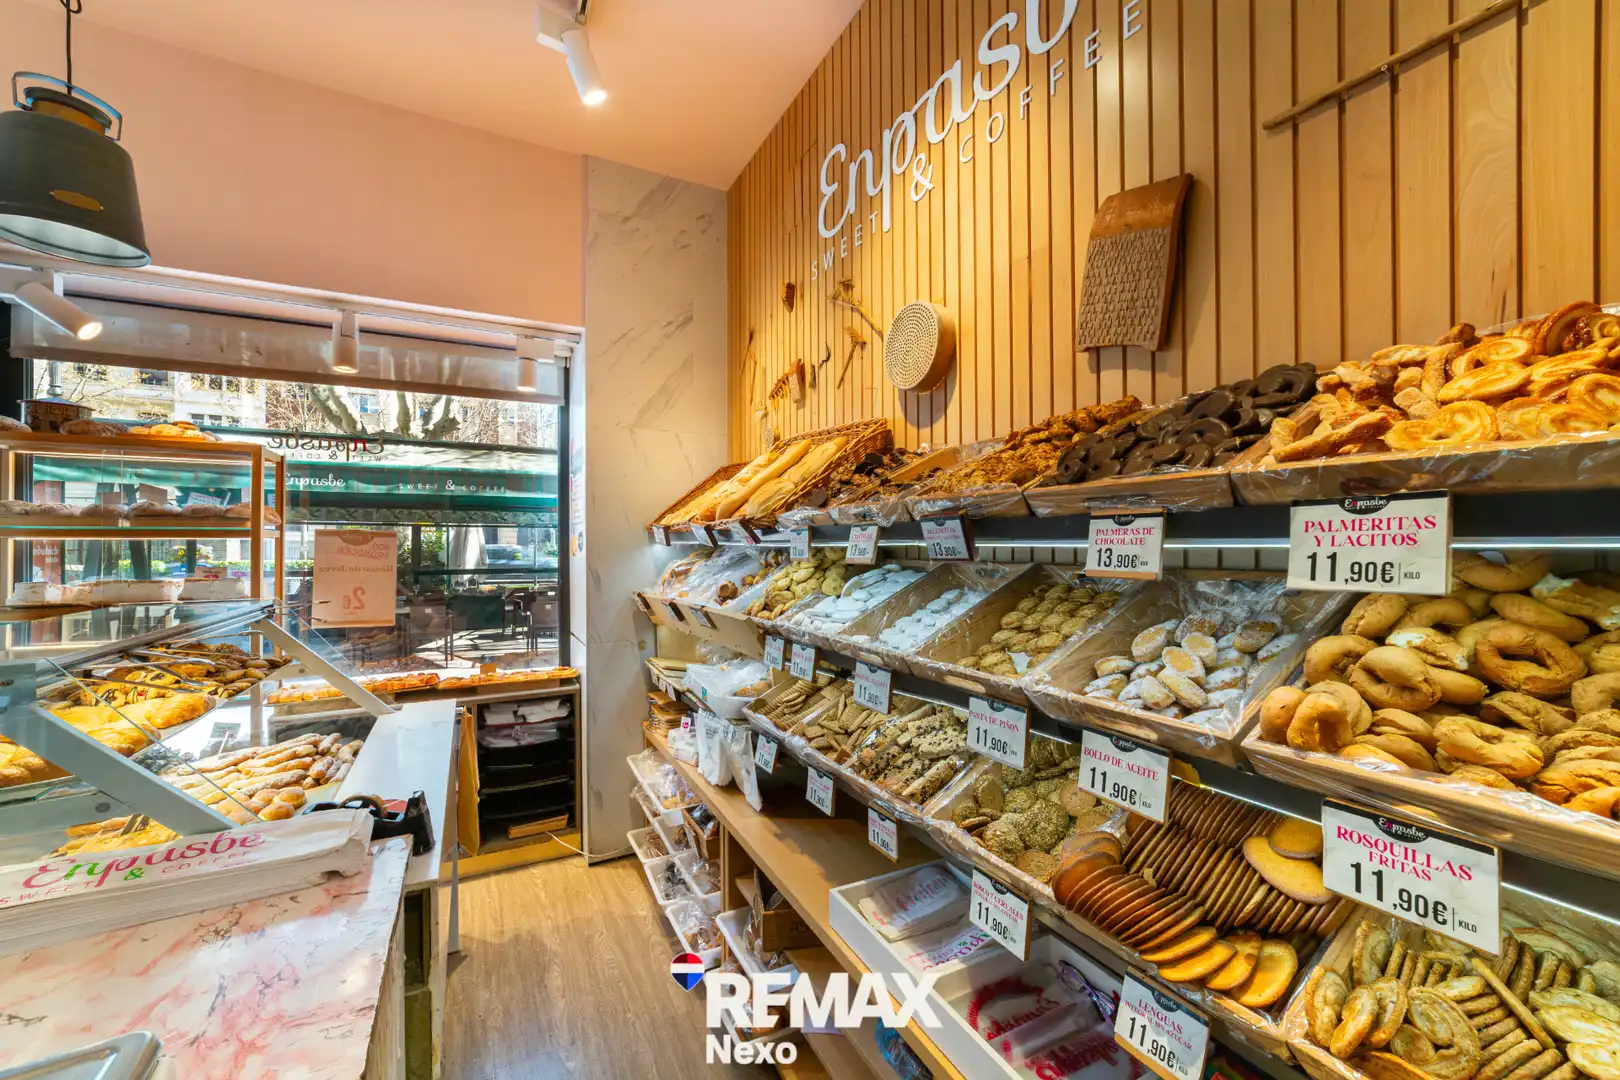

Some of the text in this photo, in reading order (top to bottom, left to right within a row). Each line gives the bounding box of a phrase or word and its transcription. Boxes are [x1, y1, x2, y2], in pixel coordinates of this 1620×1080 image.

[811, 0, 1143, 281] SWEET & COFFEE
[399, 482, 439, 490] SWEET
[445, 480, 456, 491] &
[1095, 527, 1155, 536] PALMERAS DE
[1304, 515, 1437, 533] PALMERITAS
[1313, 532, 1418, 548] Y LACITOS
[1095, 537, 1146, 546] CHOCOLATE
[1096, 547, 1138, 569] 13,90€
[1307, 551, 1421, 585] 11,90€ KILO
[976, 726, 1008, 755] 11,90€
[1084, 747, 1159, 781] BOLLO DE ACEITE
[1090, 766, 1138, 806] 11,90€
[22, 830, 266, 888] Enpasbe
[1337, 825, 1473, 881] ROSQUILLAS
[1368, 850, 1432, 881] FRITAS
[124, 866, 145, 882] &
[1350, 861, 1478, 933] 11,90€ KILO
[977, 901, 1009, 940] 11,90€
[1138, 998, 1183, 1035] LENGUAS
[1129, 1016, 1176, 1069] 11,90€
